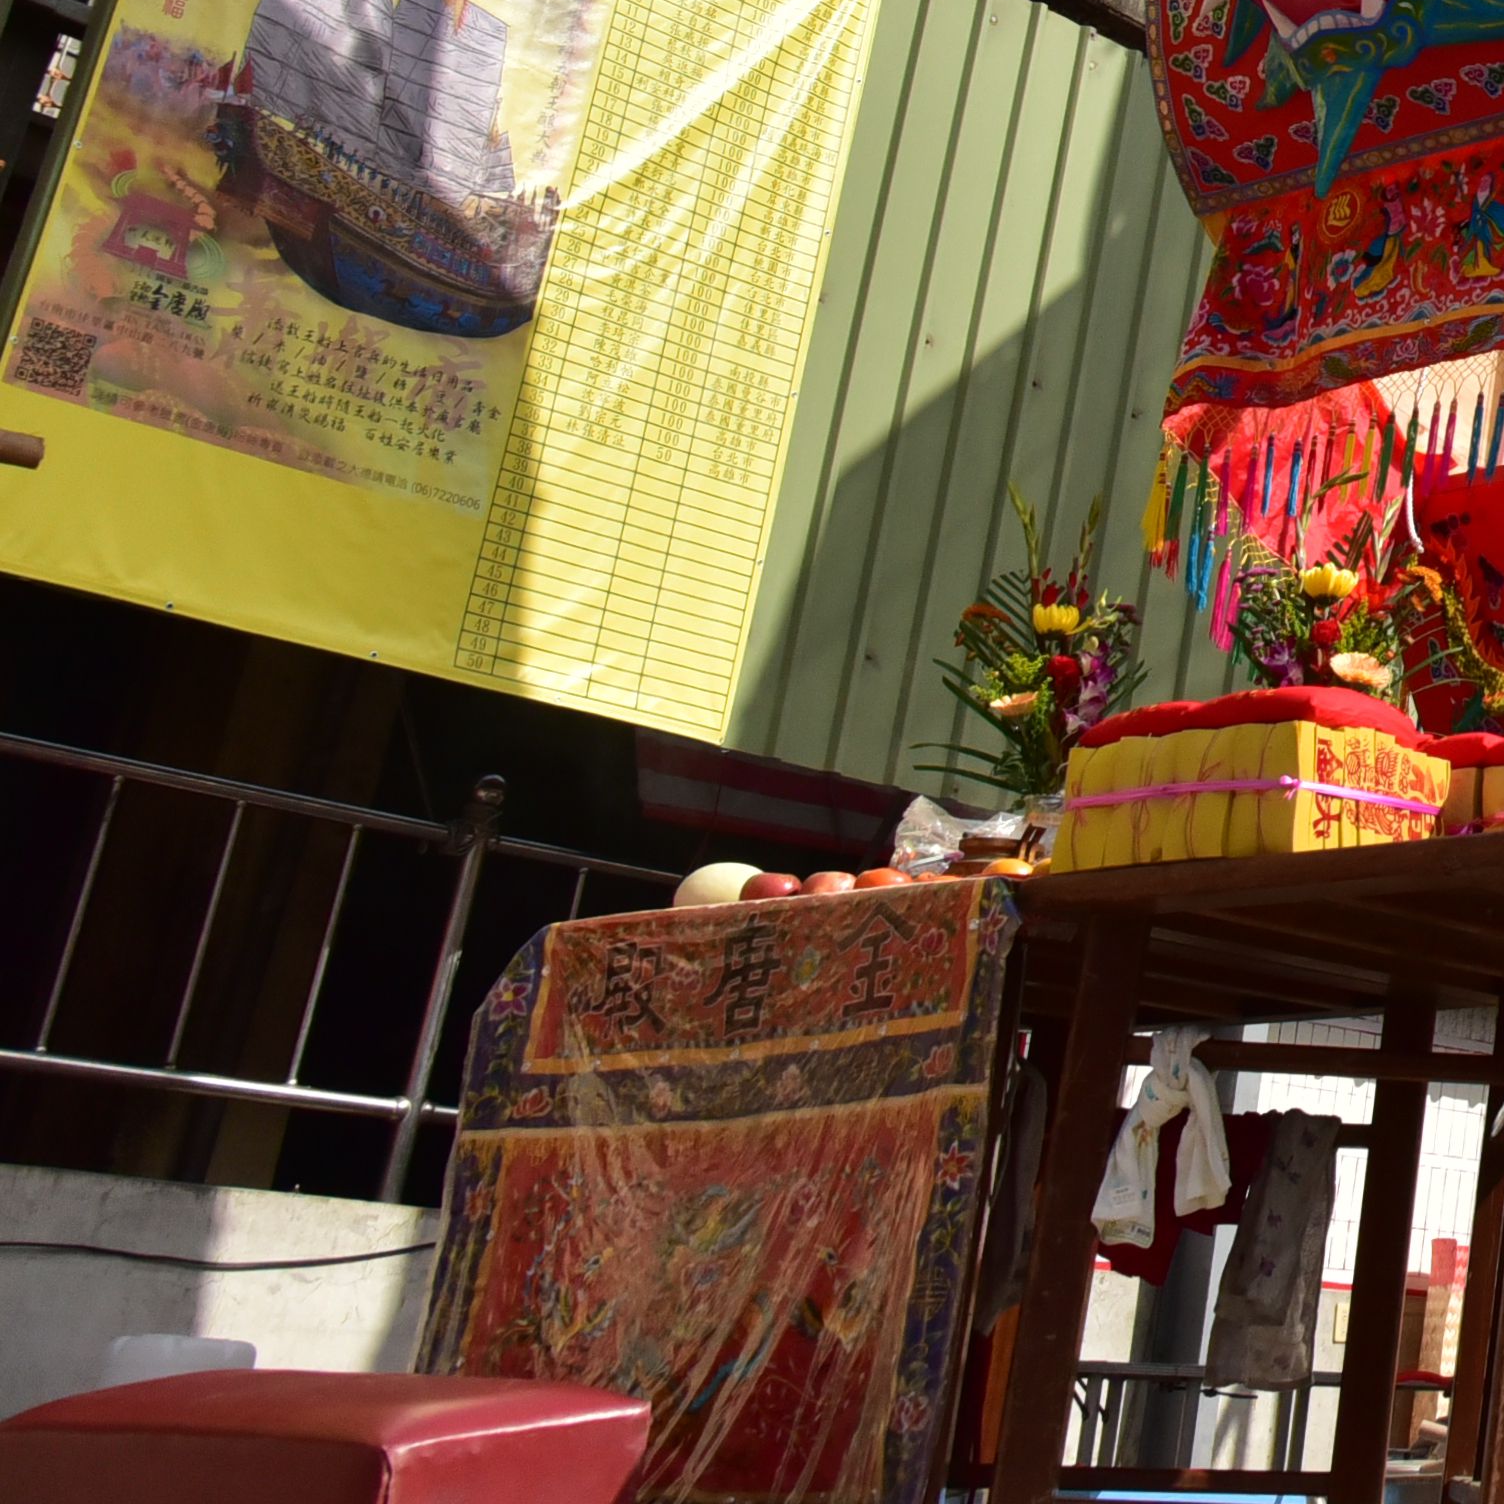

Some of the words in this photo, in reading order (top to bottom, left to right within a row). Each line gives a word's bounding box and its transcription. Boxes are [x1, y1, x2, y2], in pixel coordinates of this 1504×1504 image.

[626, 5, 639, 17] 11
[622, 19, 636, 33] 12
[618, 35, 633, 48] 13
[614, 50, 628, 64] 14
[610, 66, 624, 79] 15
[606, 81, 620, 94] 16
[602, 96, 616, 109] 17
[599, 112, 613, 125] 18
[595, 128, 608, 141] 19
[590, 144, 605, 157] 20
[575, 207, 589, 220] 24
[566, 239, 582, 253] 26
[562, 256, 576, 268] 27
[558, 273, 573, 286] 28
[554, 288, 570, 302] 29
[550, 305, 565, 318] 30
[546, 322, 560, 335] 31
[542, 338, 556, 352] 32
[538, 356, 552, 369] 33
[533, 373, 548, 386] 34
[528, 390, 544, 403] 35
[525, 406, 540, 419] 36
[516, 440, 532, 454] 38
[512, 459, 528, 473] 39
[508, 476, 523, 490] 40
[504, 493, 519, 508] 41
[501, 510, 516, 525] 42
[496, 529, 511, 544] 43
[491, 547, 506, 561] 44
[487, 564, 502, 579] 45
[482, 582, 498, 597] 46
[478, 600, 494, 615] 47
[474, 618, 490, 632] 48
[470, 636, 486, 650] 49
[466, 654, 482, 668] 50
[590, 901, 918, 1041] 金唐殿
